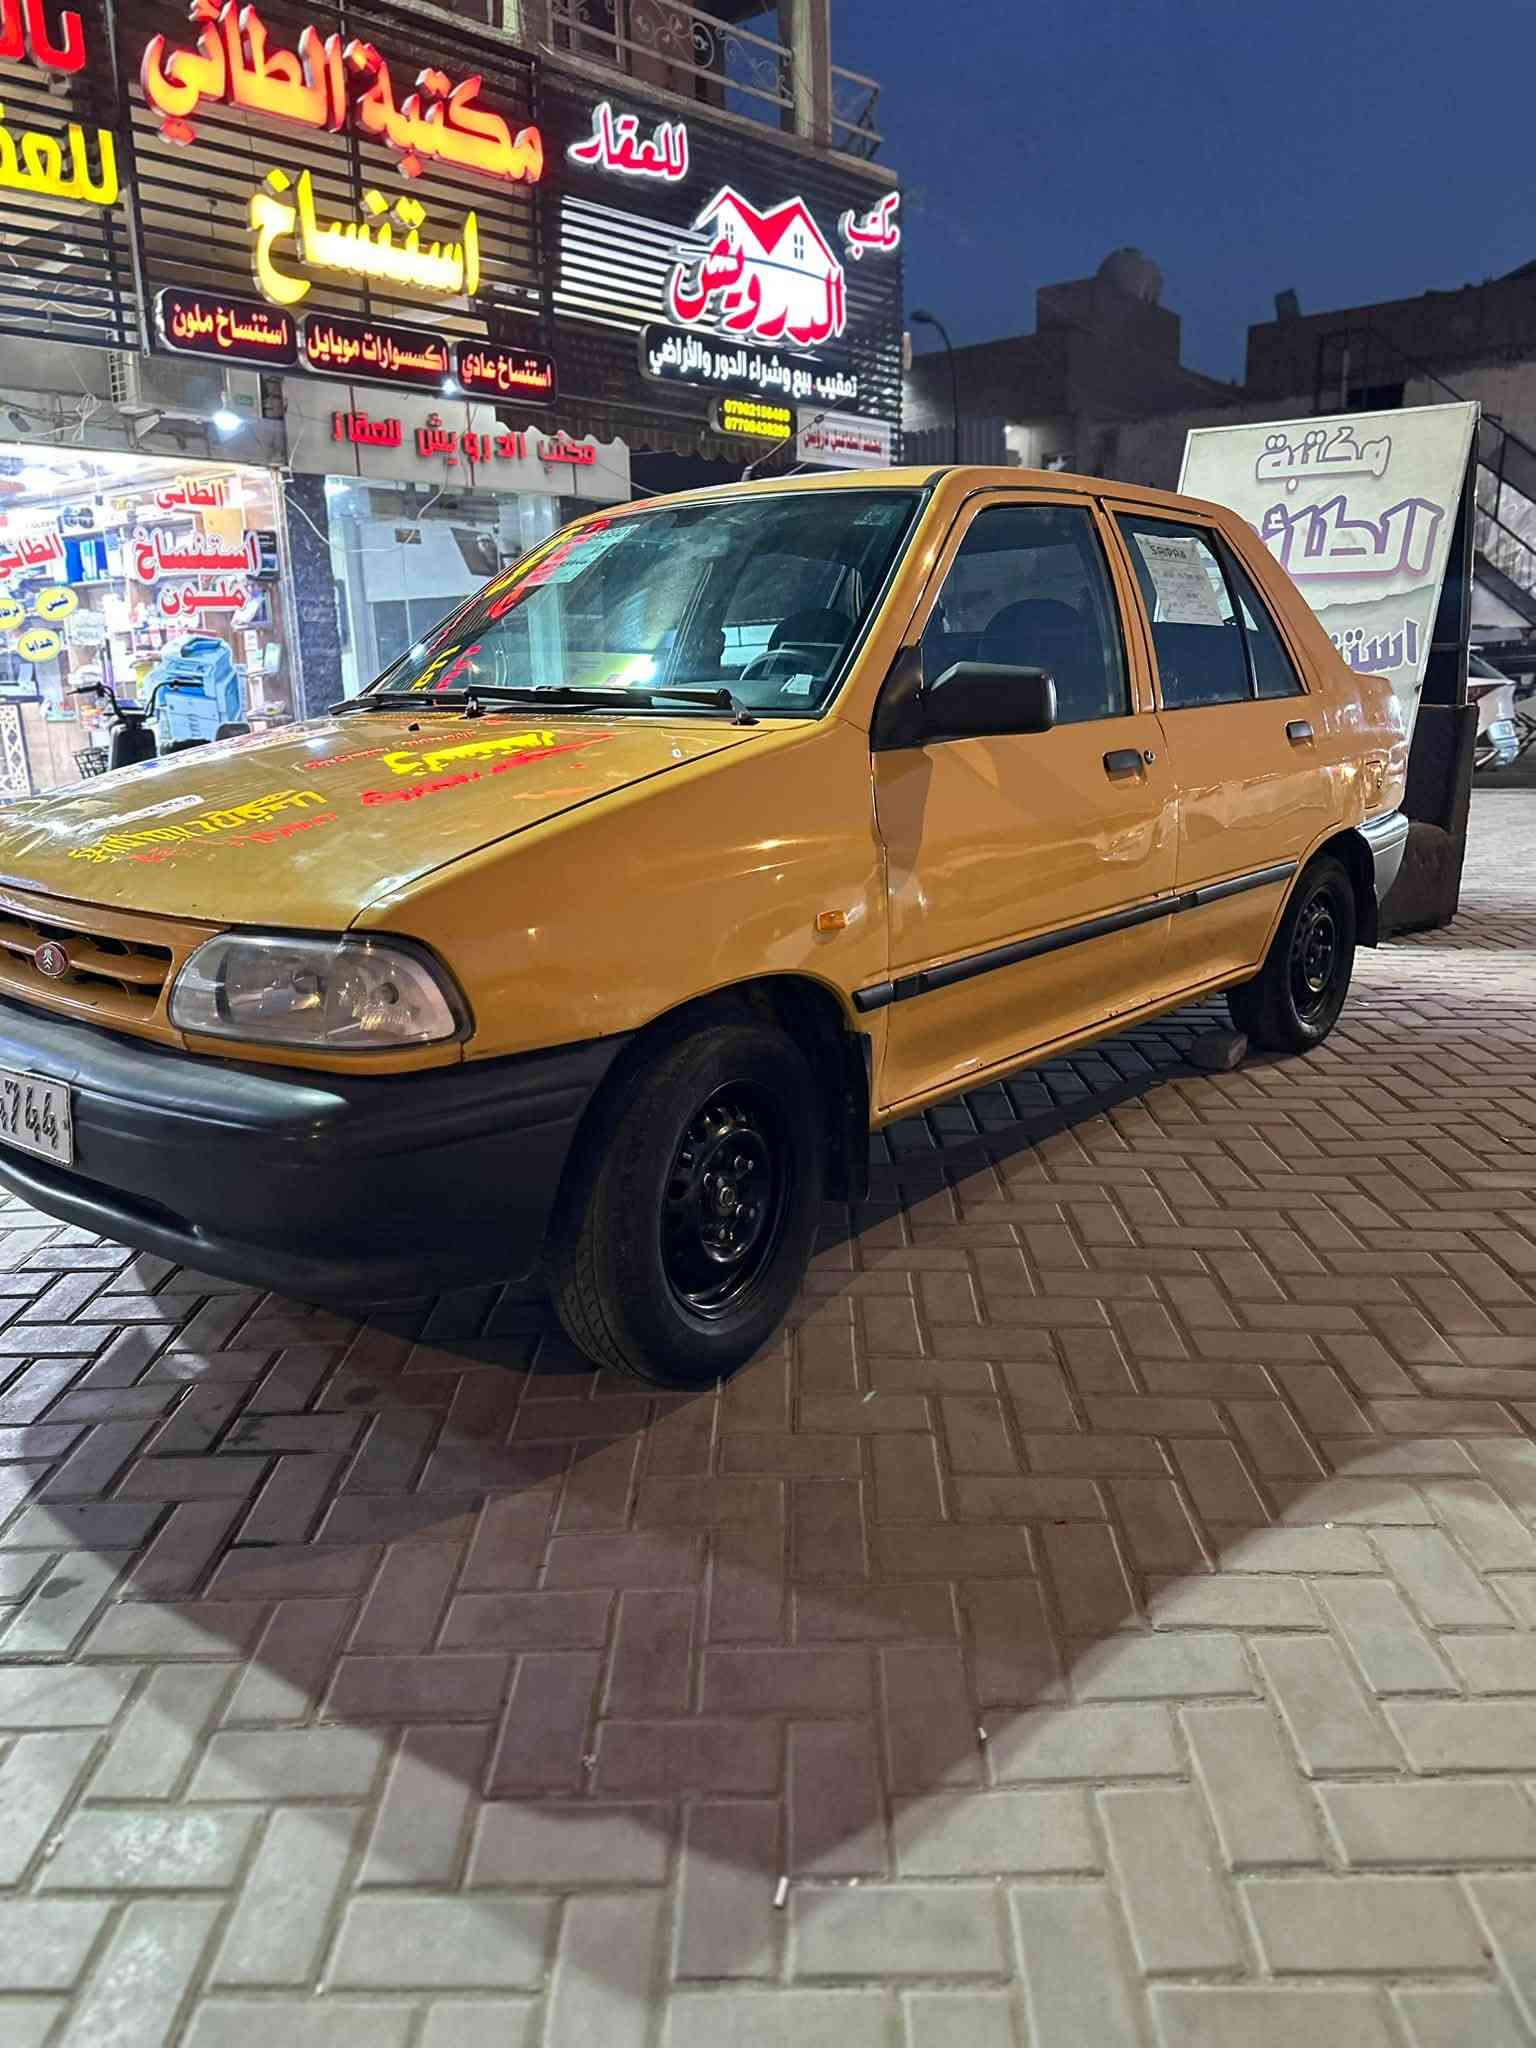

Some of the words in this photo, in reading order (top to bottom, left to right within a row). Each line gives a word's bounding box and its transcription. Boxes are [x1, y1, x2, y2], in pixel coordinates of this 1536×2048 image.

[142, 0, 347, 144] الطائي
[347, 39, 544, 183] مكتبة
[568, 102, 690, 181] للعقار
[249, 168, 481, 305] استنساخ
[844, 191, 901, 260] مكتب
[668, 230, 846, 346] الدرويش
[171, 303, 213, 337] ملون
[216, 305, 288, 348] استنساخ
[306, 323, 360, 364] موبايل
[362, 332, 449, 374] اكسسوارات
[712, 349, 748, 380] الدور
[461, 351, 497, 384] عادي
[498, 354, 552, 391] استنساخ
[749, 353, 791, 392] وشراء
[792, 367, 812, 399] بيع
[815, 371, 858, 400] تعقيب
[415, 411, 527, 465] الدرويش
[539, 428, 597, 475] مكتب
[1256, 427, 1391, 494] مكتبة
[134, 528, 262, 585] استنساخ
[159, 576, 247, 616] ملون
